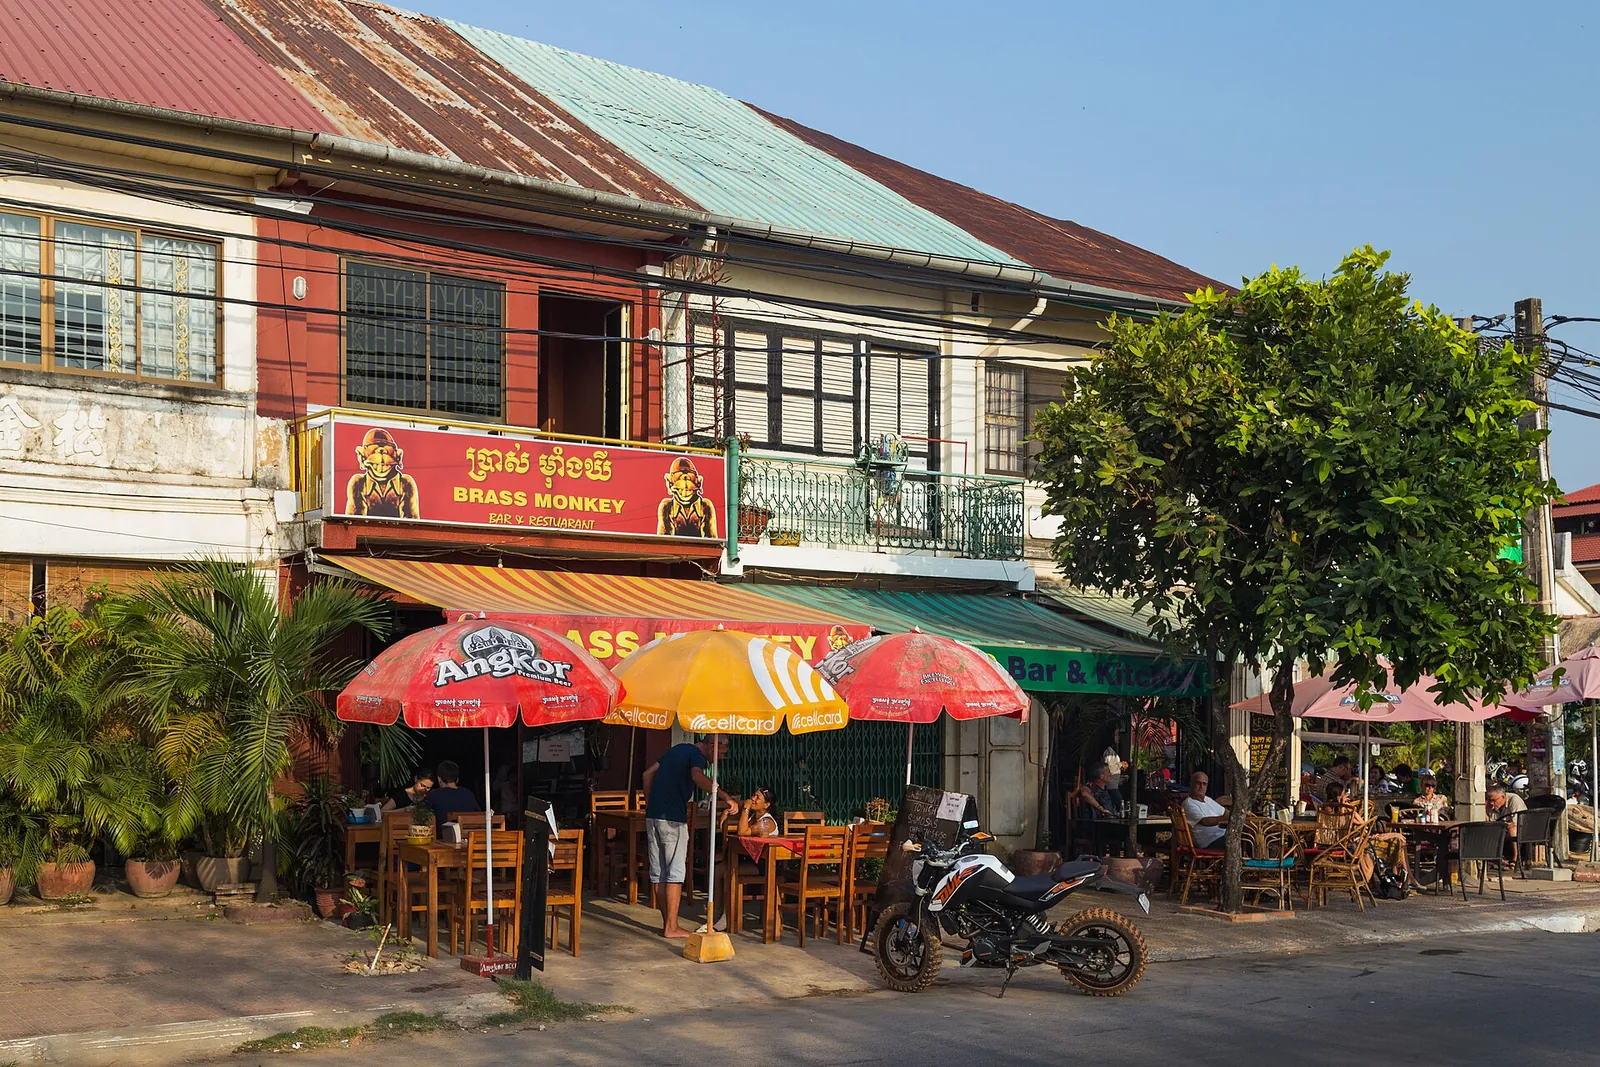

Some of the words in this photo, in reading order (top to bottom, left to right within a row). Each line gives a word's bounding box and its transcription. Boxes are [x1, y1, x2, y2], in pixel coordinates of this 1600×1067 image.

[453, 486, 528, 507] BRASS
[534, 493, 626, 515] MONKEY
[488, 512, 513, 526] BAR
[528, 516, 595, 531] RESTUARANT
[565, 629, 640, 659] ASS
[435, 647, 572, 686] Angkor
[517, 669, 552, 683] Premium
[1007, 655, 1057, 682] Bar
[1067, 659, 1088, 685] &
[705, 712, 776, 733] cellcard
[800, 709, 844, 729] cellcard
[913, 802, 937, 817] TONIGH
[907, 813, 939, 829] SAMOSAS
[932, 863, 983, 904] DUKE
[480, 962, 504, 973] Angkor
